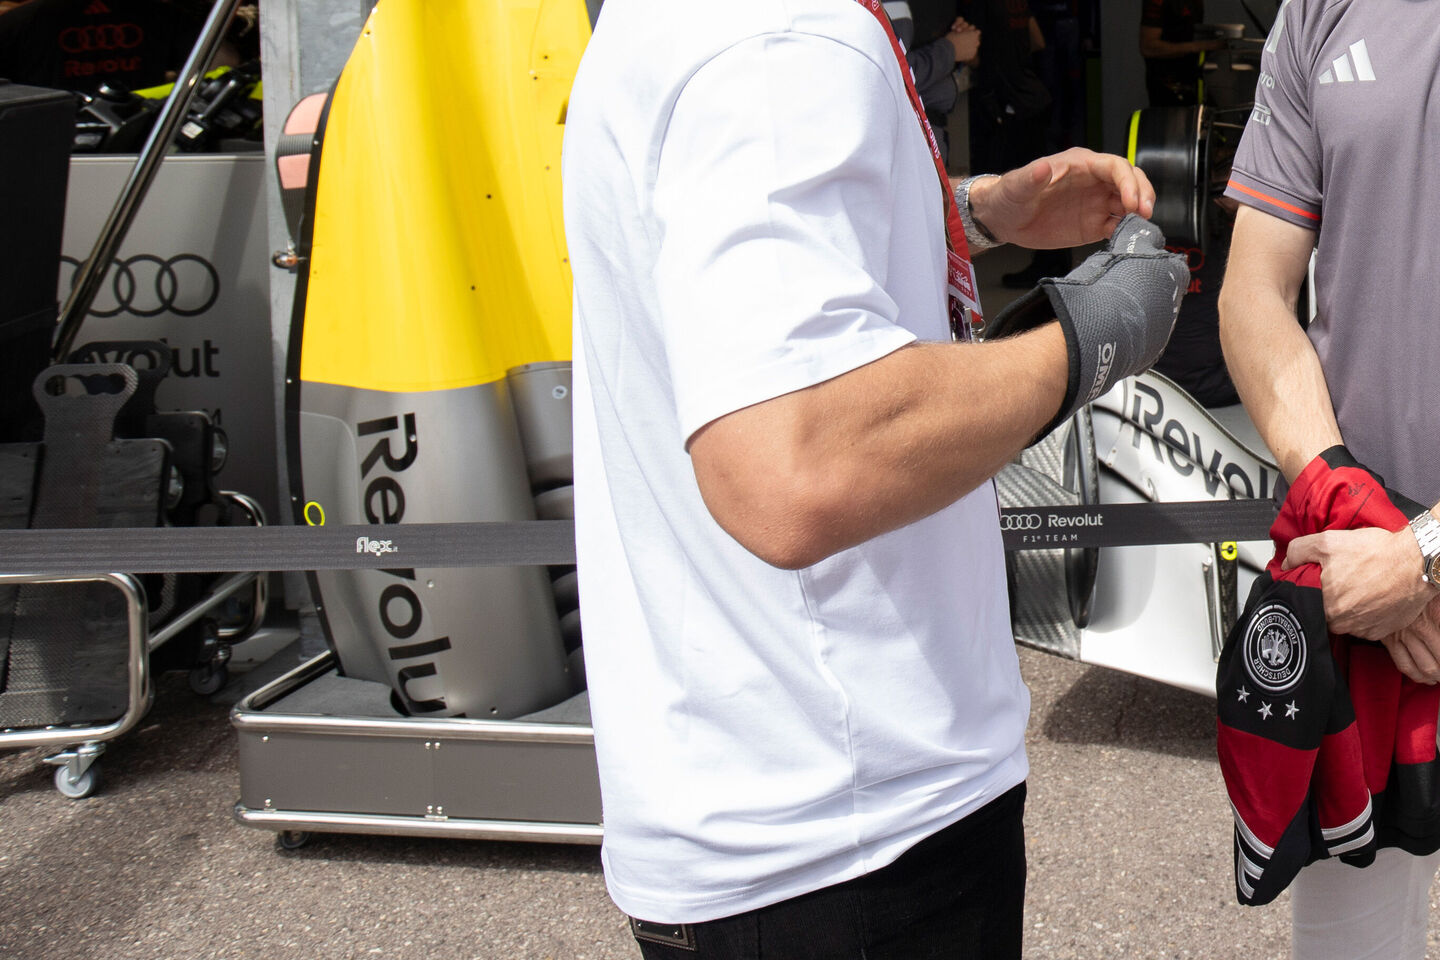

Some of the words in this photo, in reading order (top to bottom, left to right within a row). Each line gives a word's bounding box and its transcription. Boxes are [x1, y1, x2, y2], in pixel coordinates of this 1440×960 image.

[1047, 513, 1104, 528] Revolut
[1045, 534, 1078, 542] TEAM
[356, 412, 469, 719] Reolu
[1253, 657, 1292, 680] DEUTSCHER
